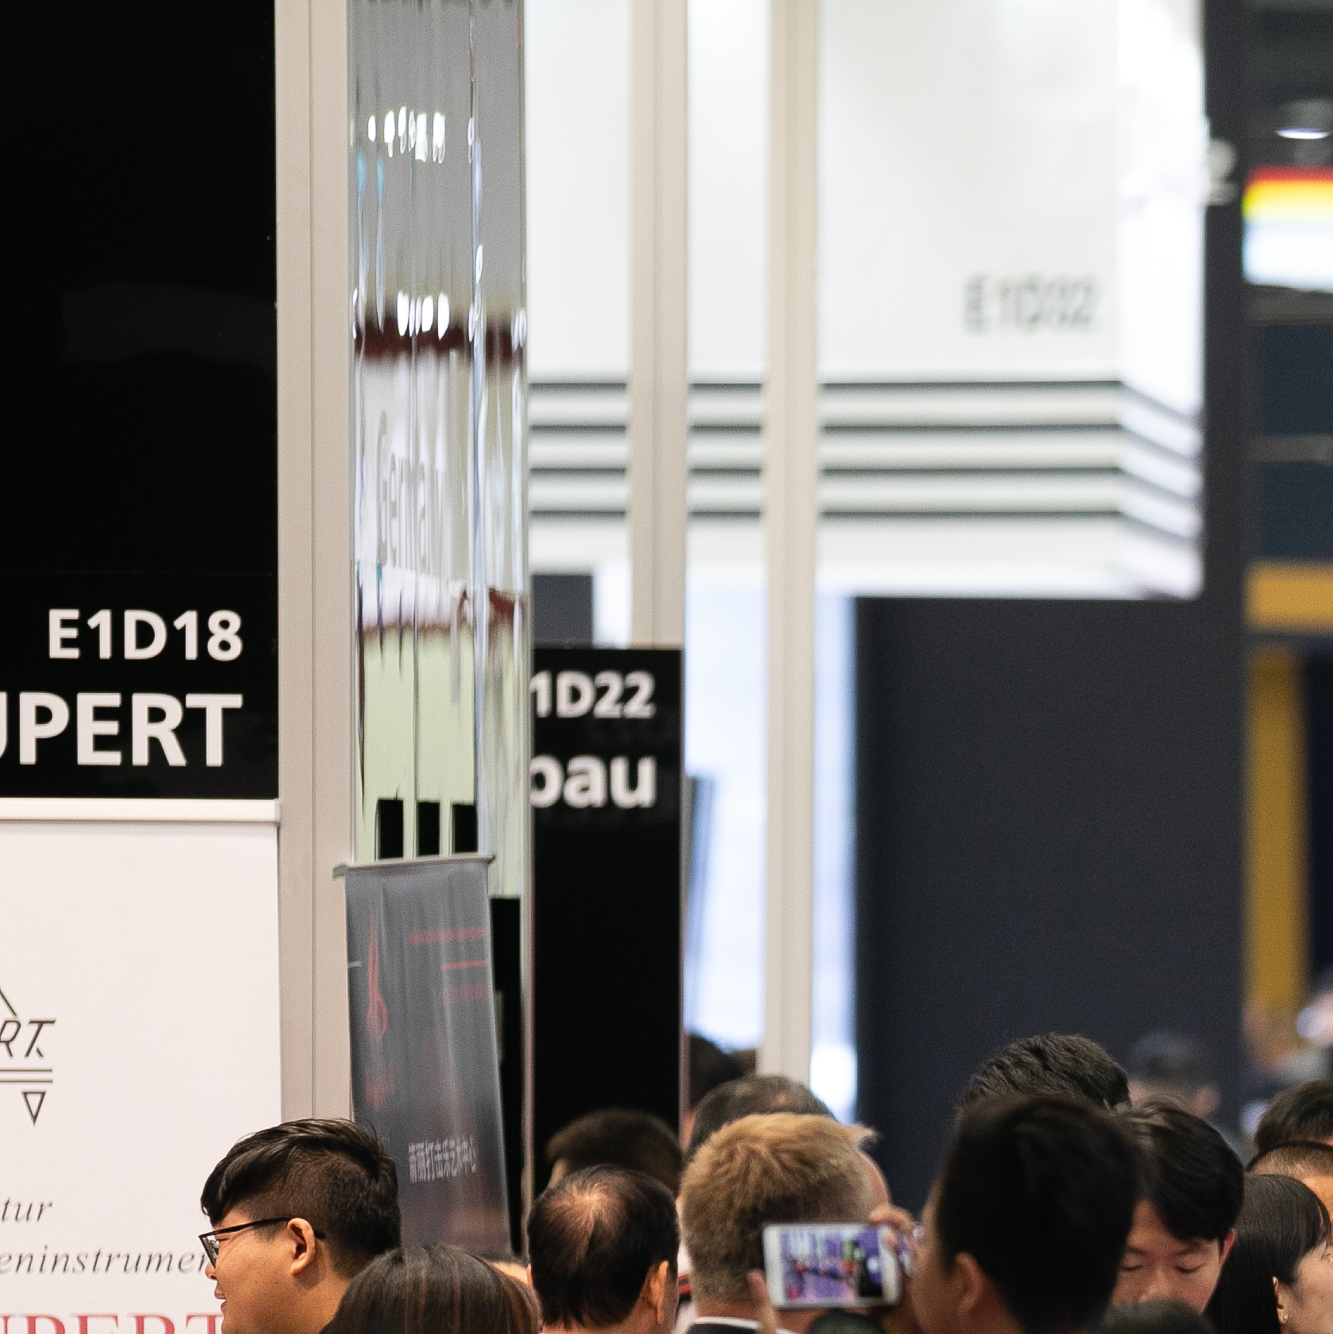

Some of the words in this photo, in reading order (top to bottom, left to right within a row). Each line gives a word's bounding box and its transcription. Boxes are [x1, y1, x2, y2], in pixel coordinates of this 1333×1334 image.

[49, 608, 243, 662] E1D18
[0, 691, 243, 767] PERT
[1, 1197, 53, 1223] tur
